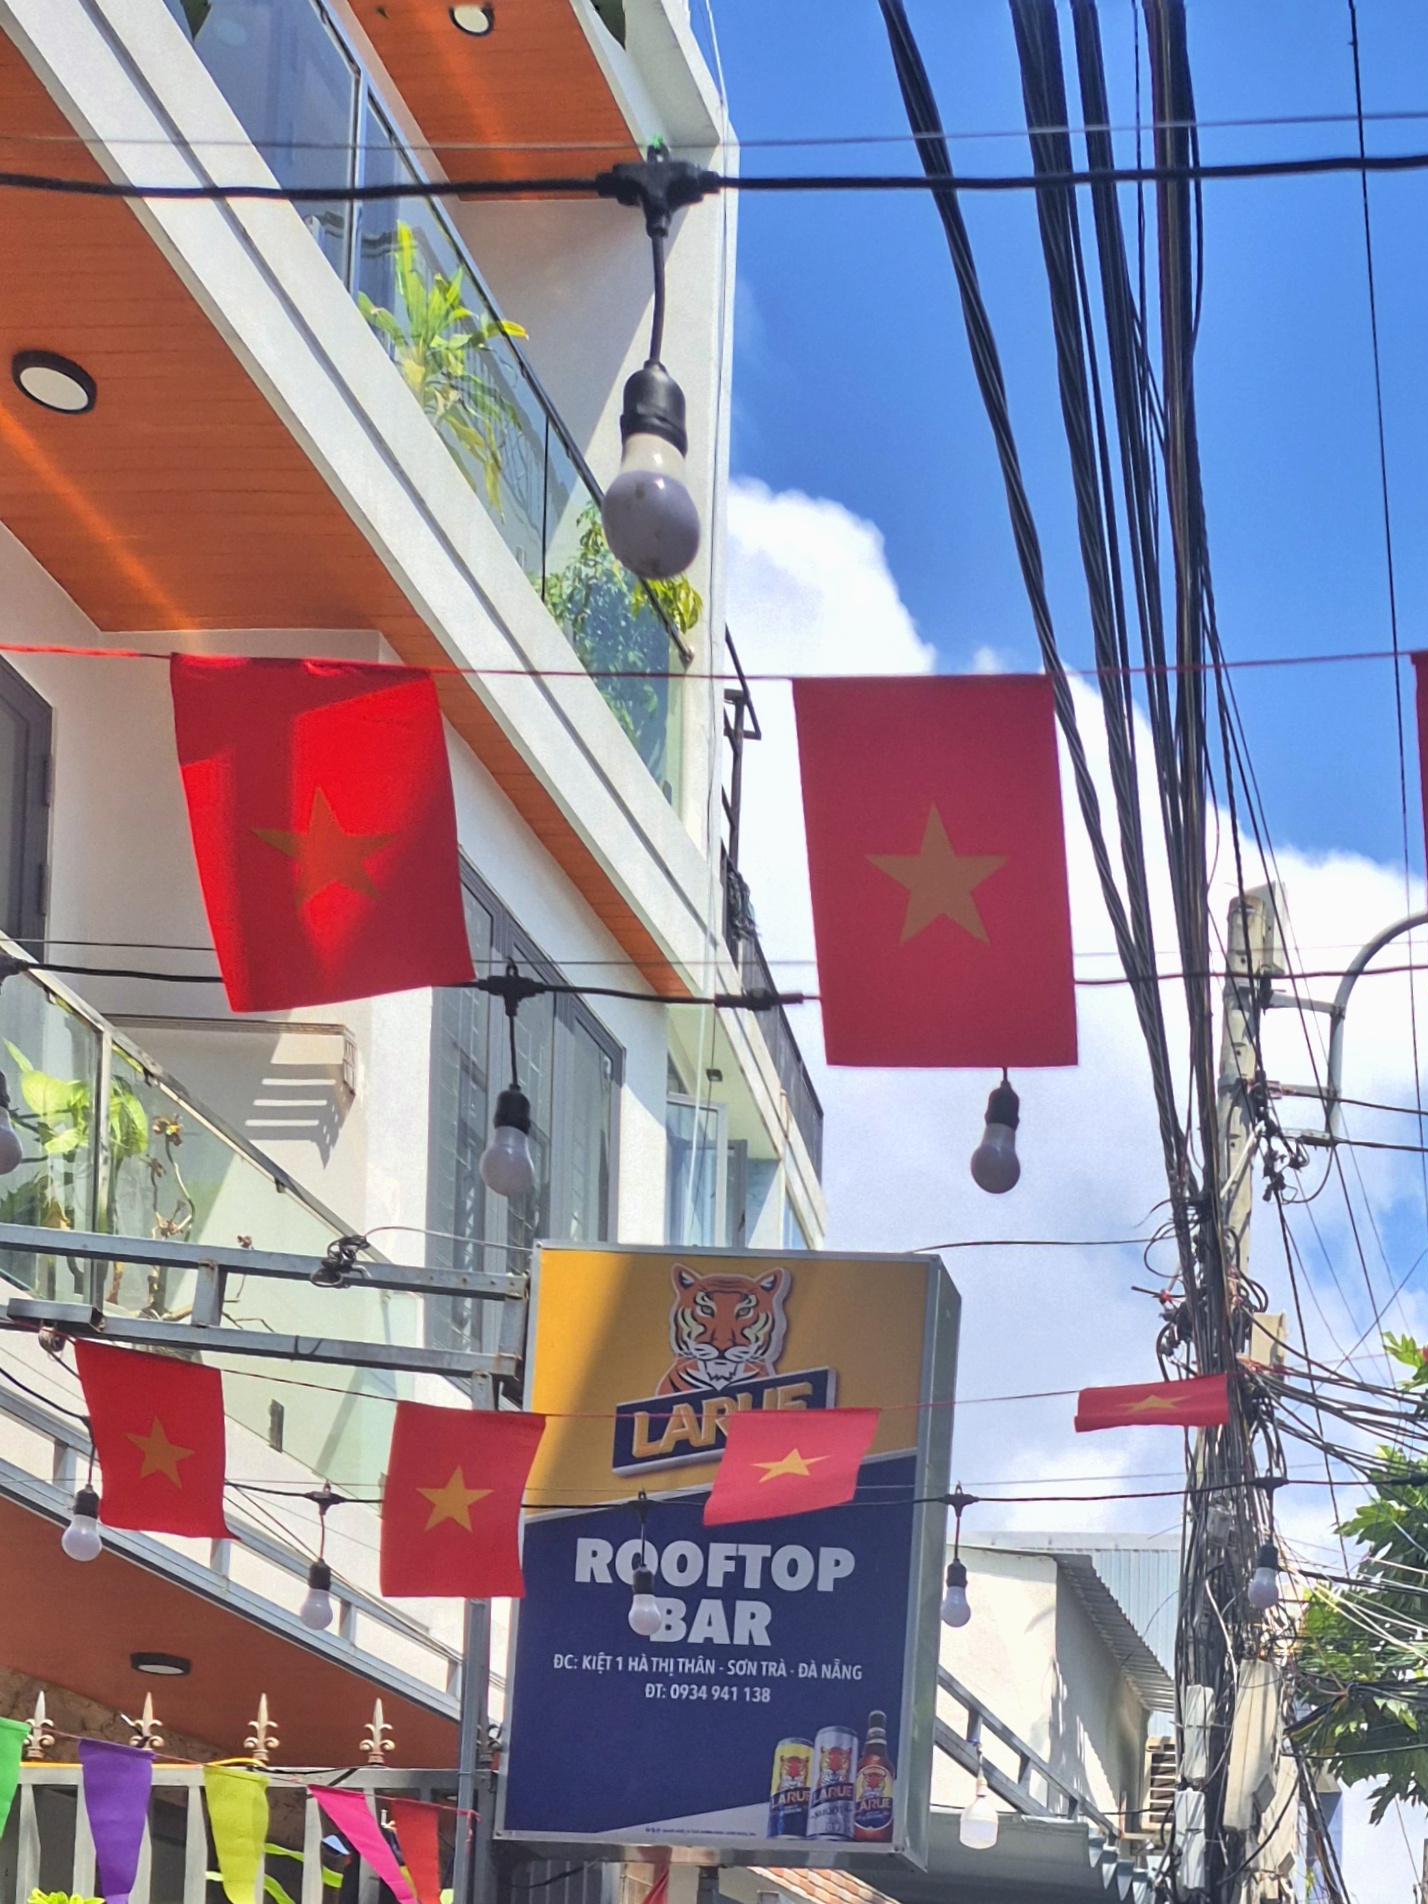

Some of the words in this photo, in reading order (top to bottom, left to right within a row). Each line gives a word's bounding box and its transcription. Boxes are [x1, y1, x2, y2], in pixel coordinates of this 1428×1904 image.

[631, 1382, 813, 1459] LAR
[574, 1537, 856, 1592] ROOFTOP
[649, 1596, 772, 1646] BAR
[553, 1653, 578, 1670] ĐC:
[582, 1652, 613, 1674] KIỆT
[615, 1656, 623, 1671] 1
[628, 1653, 649, 1672] HÀ
[650, 1656, 674, 1677] THỊ
[677, 1655, 716, 1675] THÂN
[727, 1657, 757, 1676] SƠN
[760, 1658, 788, 1677] TRÀ
[798, 1659, 818, 1679] ĐÀ
[821, 1658, 863, 1681] NẴNG
[645, 1683, 667, 1699] ĐT:
[669, 1684, 708, 1700] 0934
[711, 1685, 738, 1702] 941
[743, 1687, 771, 1702] 138
